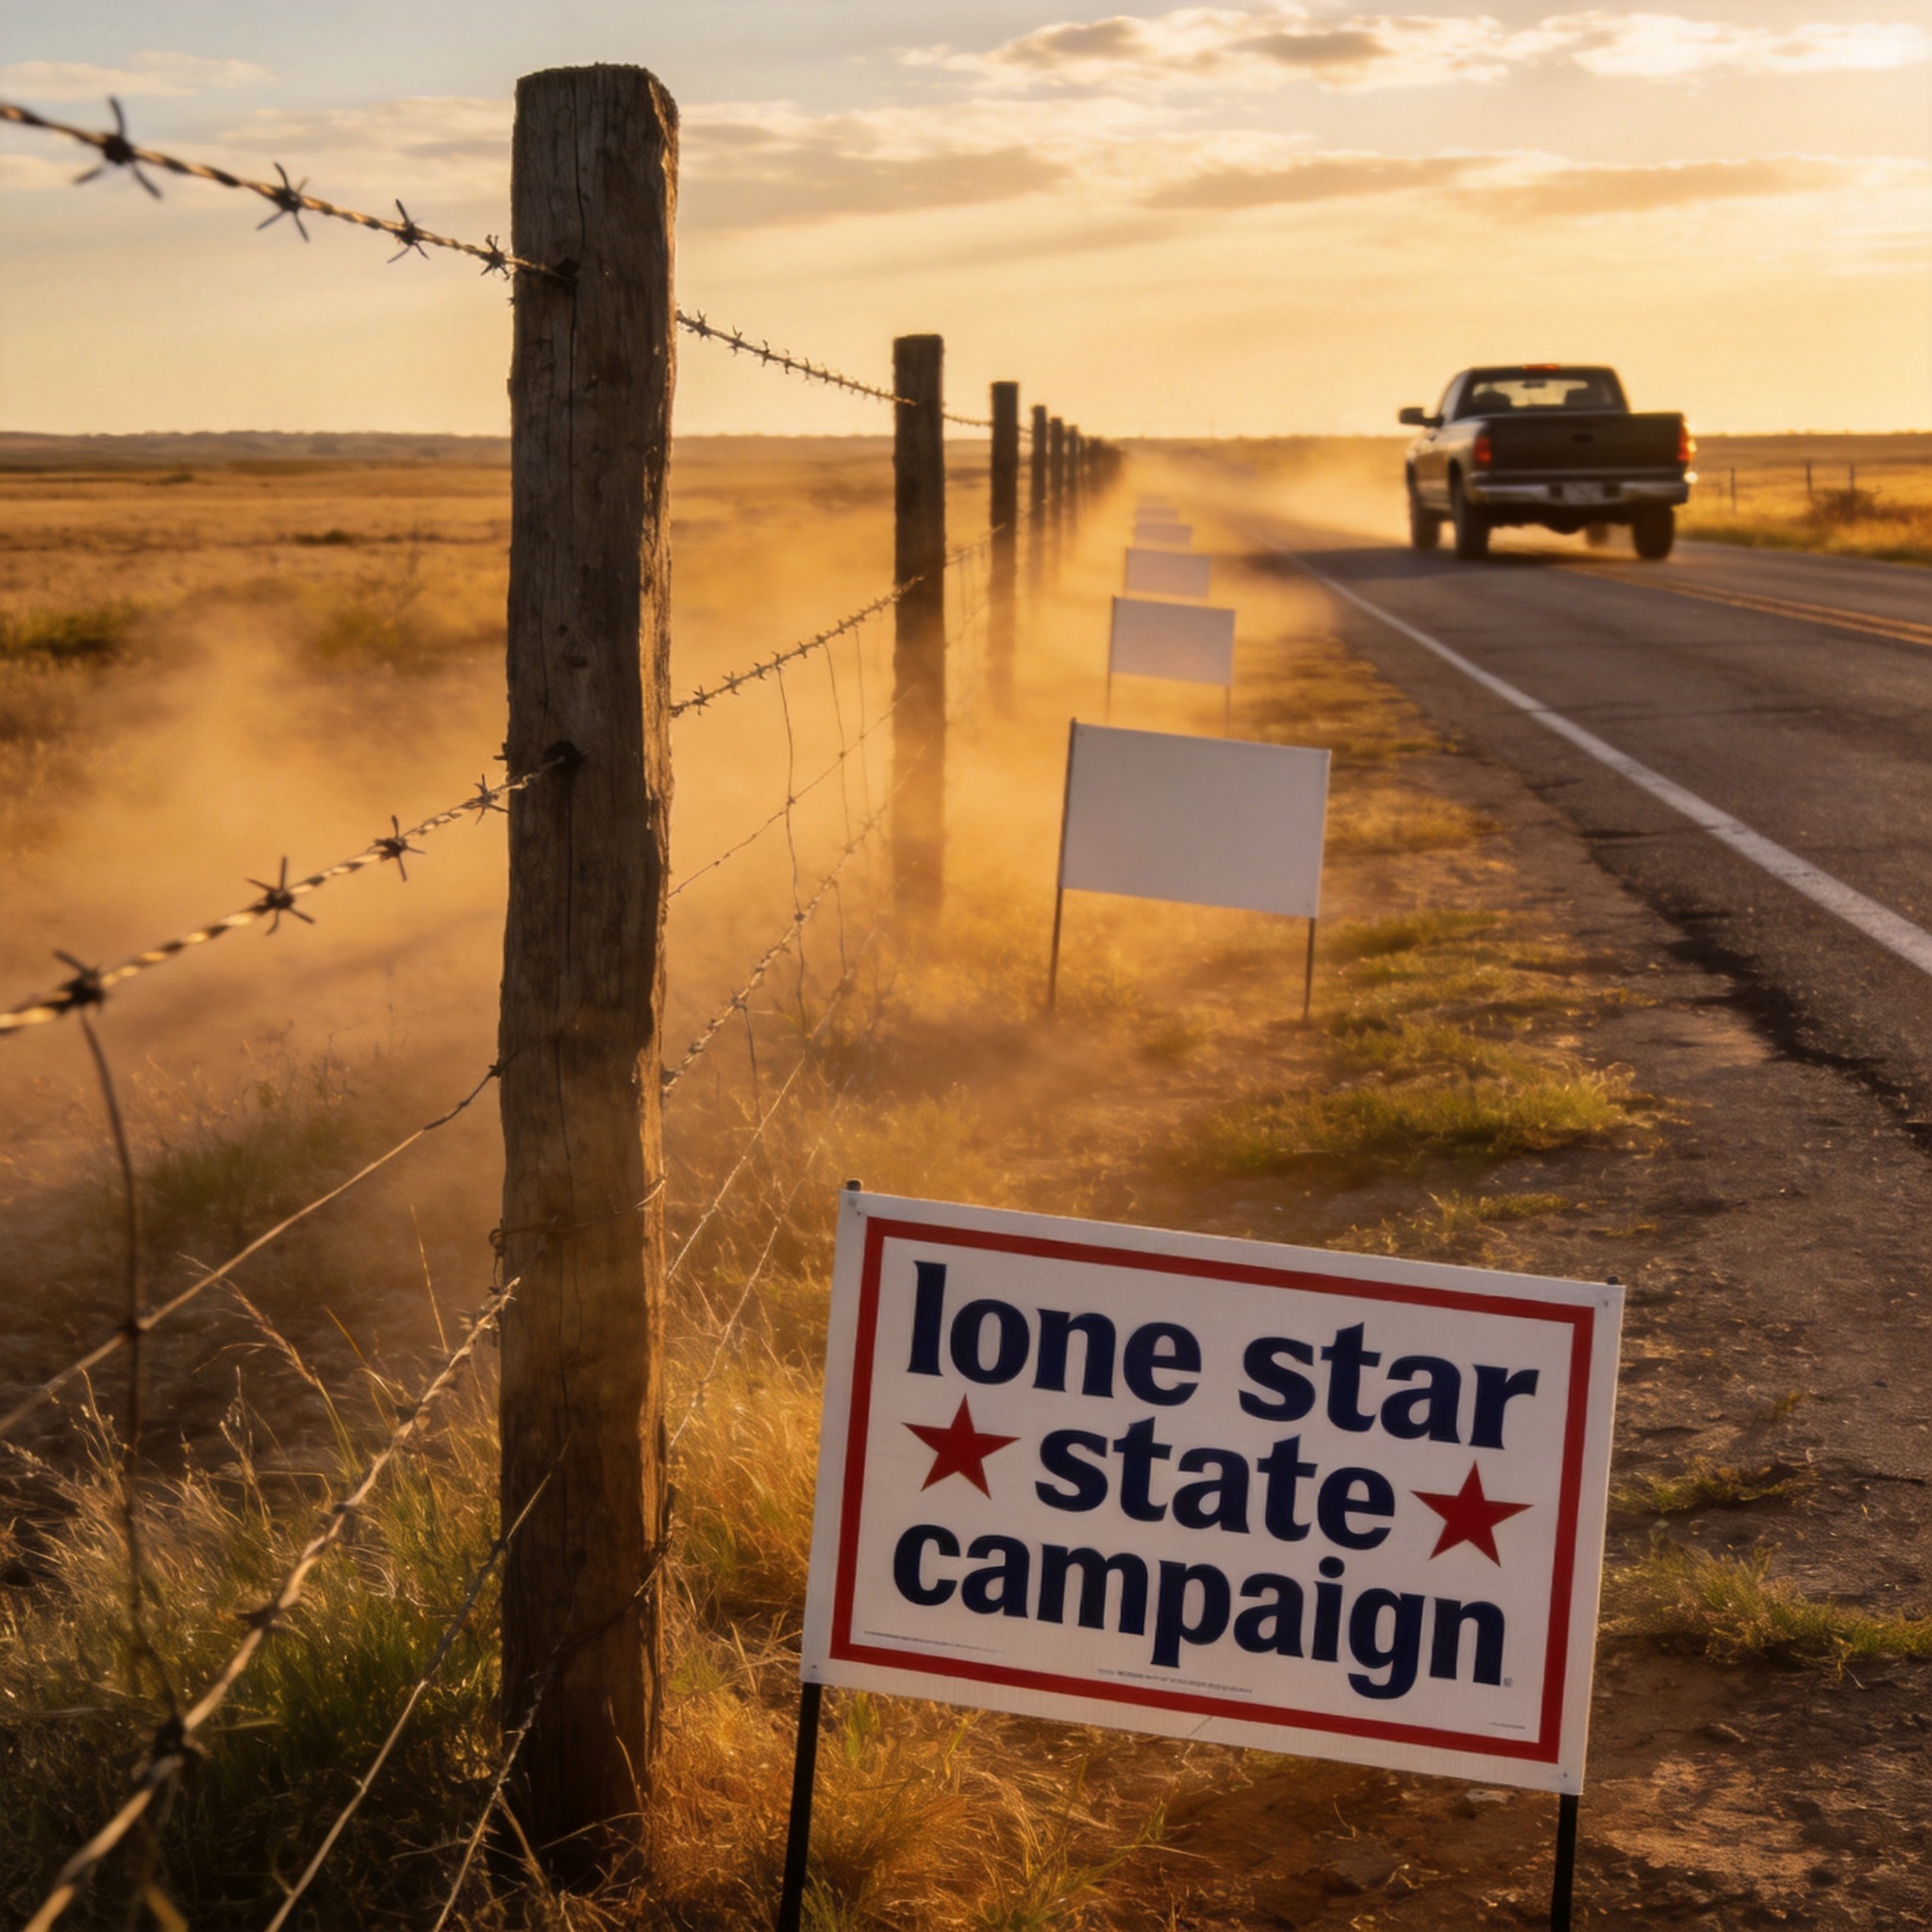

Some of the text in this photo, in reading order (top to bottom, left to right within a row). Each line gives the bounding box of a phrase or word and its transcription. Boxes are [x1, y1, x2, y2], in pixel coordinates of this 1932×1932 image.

[907, 1259, 1541, 1451] lone star
[1035, 1416, 1396, 1551] state
[892, 1524, 1507, 1700] campaign
